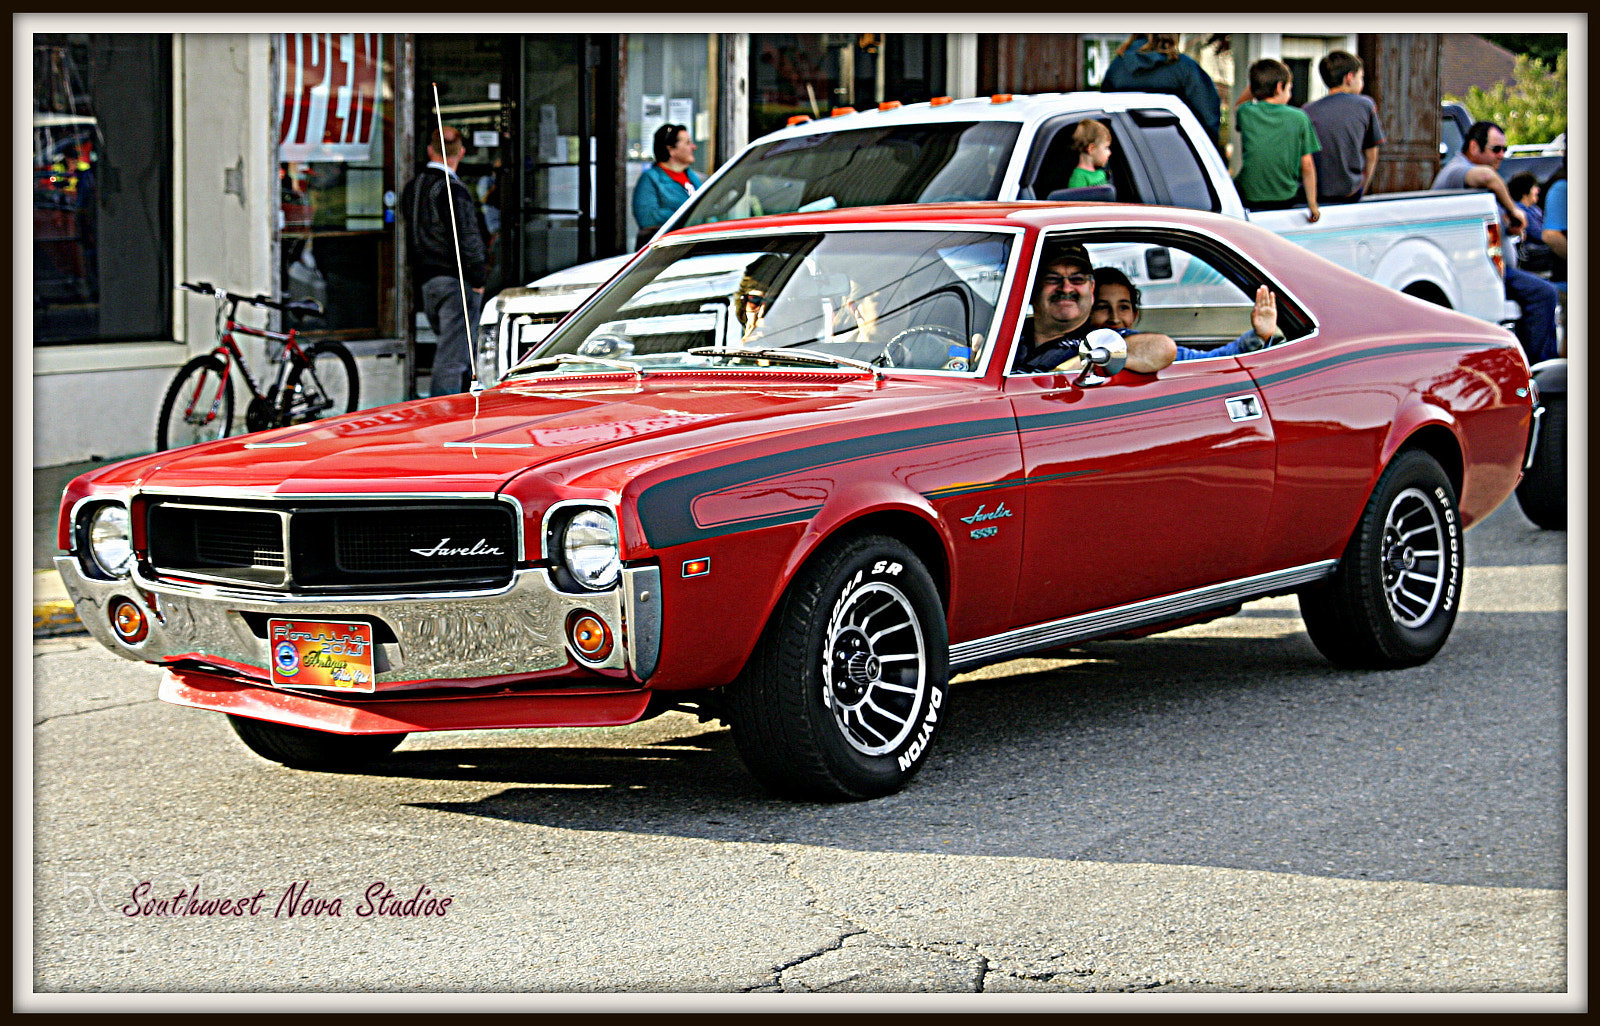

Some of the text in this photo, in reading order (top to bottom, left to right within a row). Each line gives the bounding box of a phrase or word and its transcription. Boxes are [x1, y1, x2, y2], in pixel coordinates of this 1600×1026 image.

[960, 502, 1013, 525] Javelin
[410, 537, 505, 557] Javelin
[871, 560, 904, 577] SR
[898, 686, 943, 772] DAYTON
